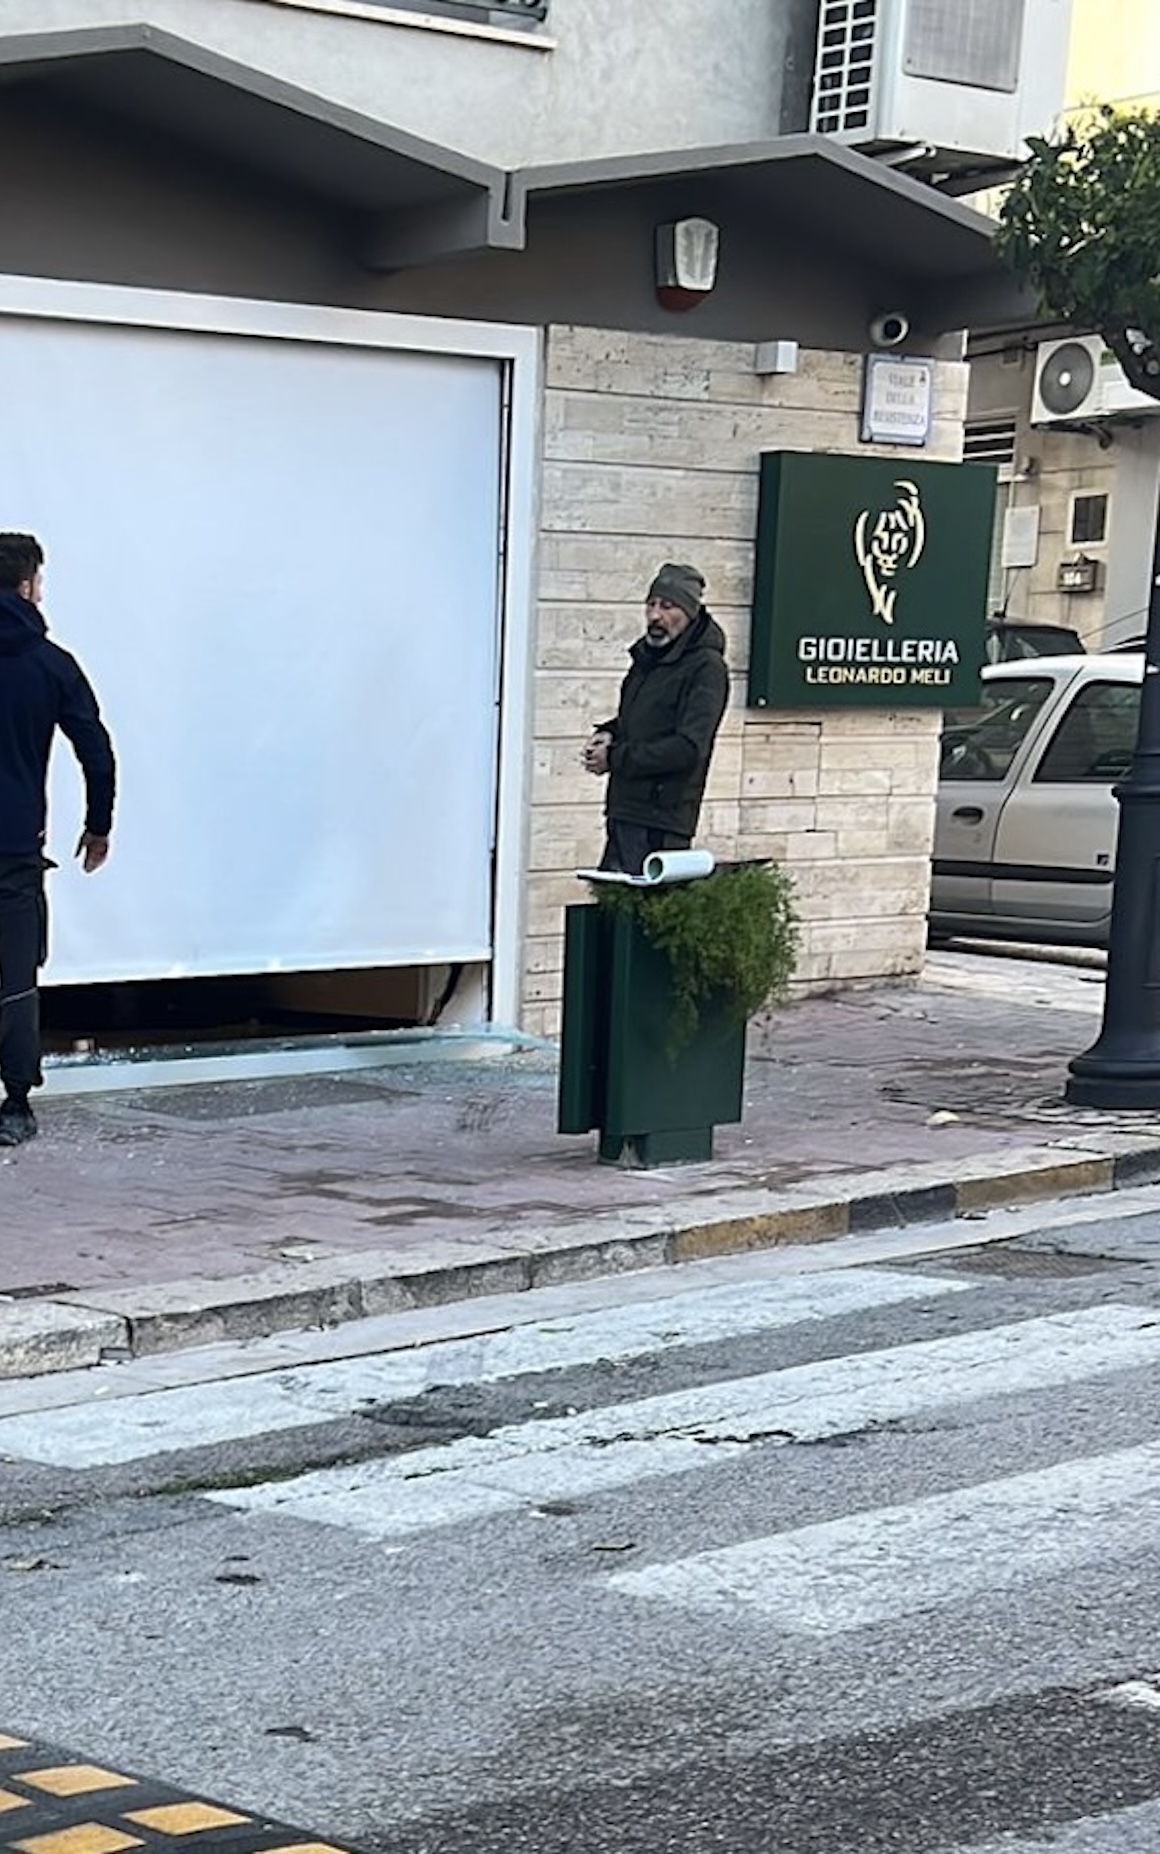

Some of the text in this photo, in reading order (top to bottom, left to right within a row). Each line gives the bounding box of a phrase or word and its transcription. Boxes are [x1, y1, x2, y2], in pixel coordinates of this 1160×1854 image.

[798, 637, 959, 664] GIOIELLERIA
[806, 665, 951, 684] LEONARDO MELI
